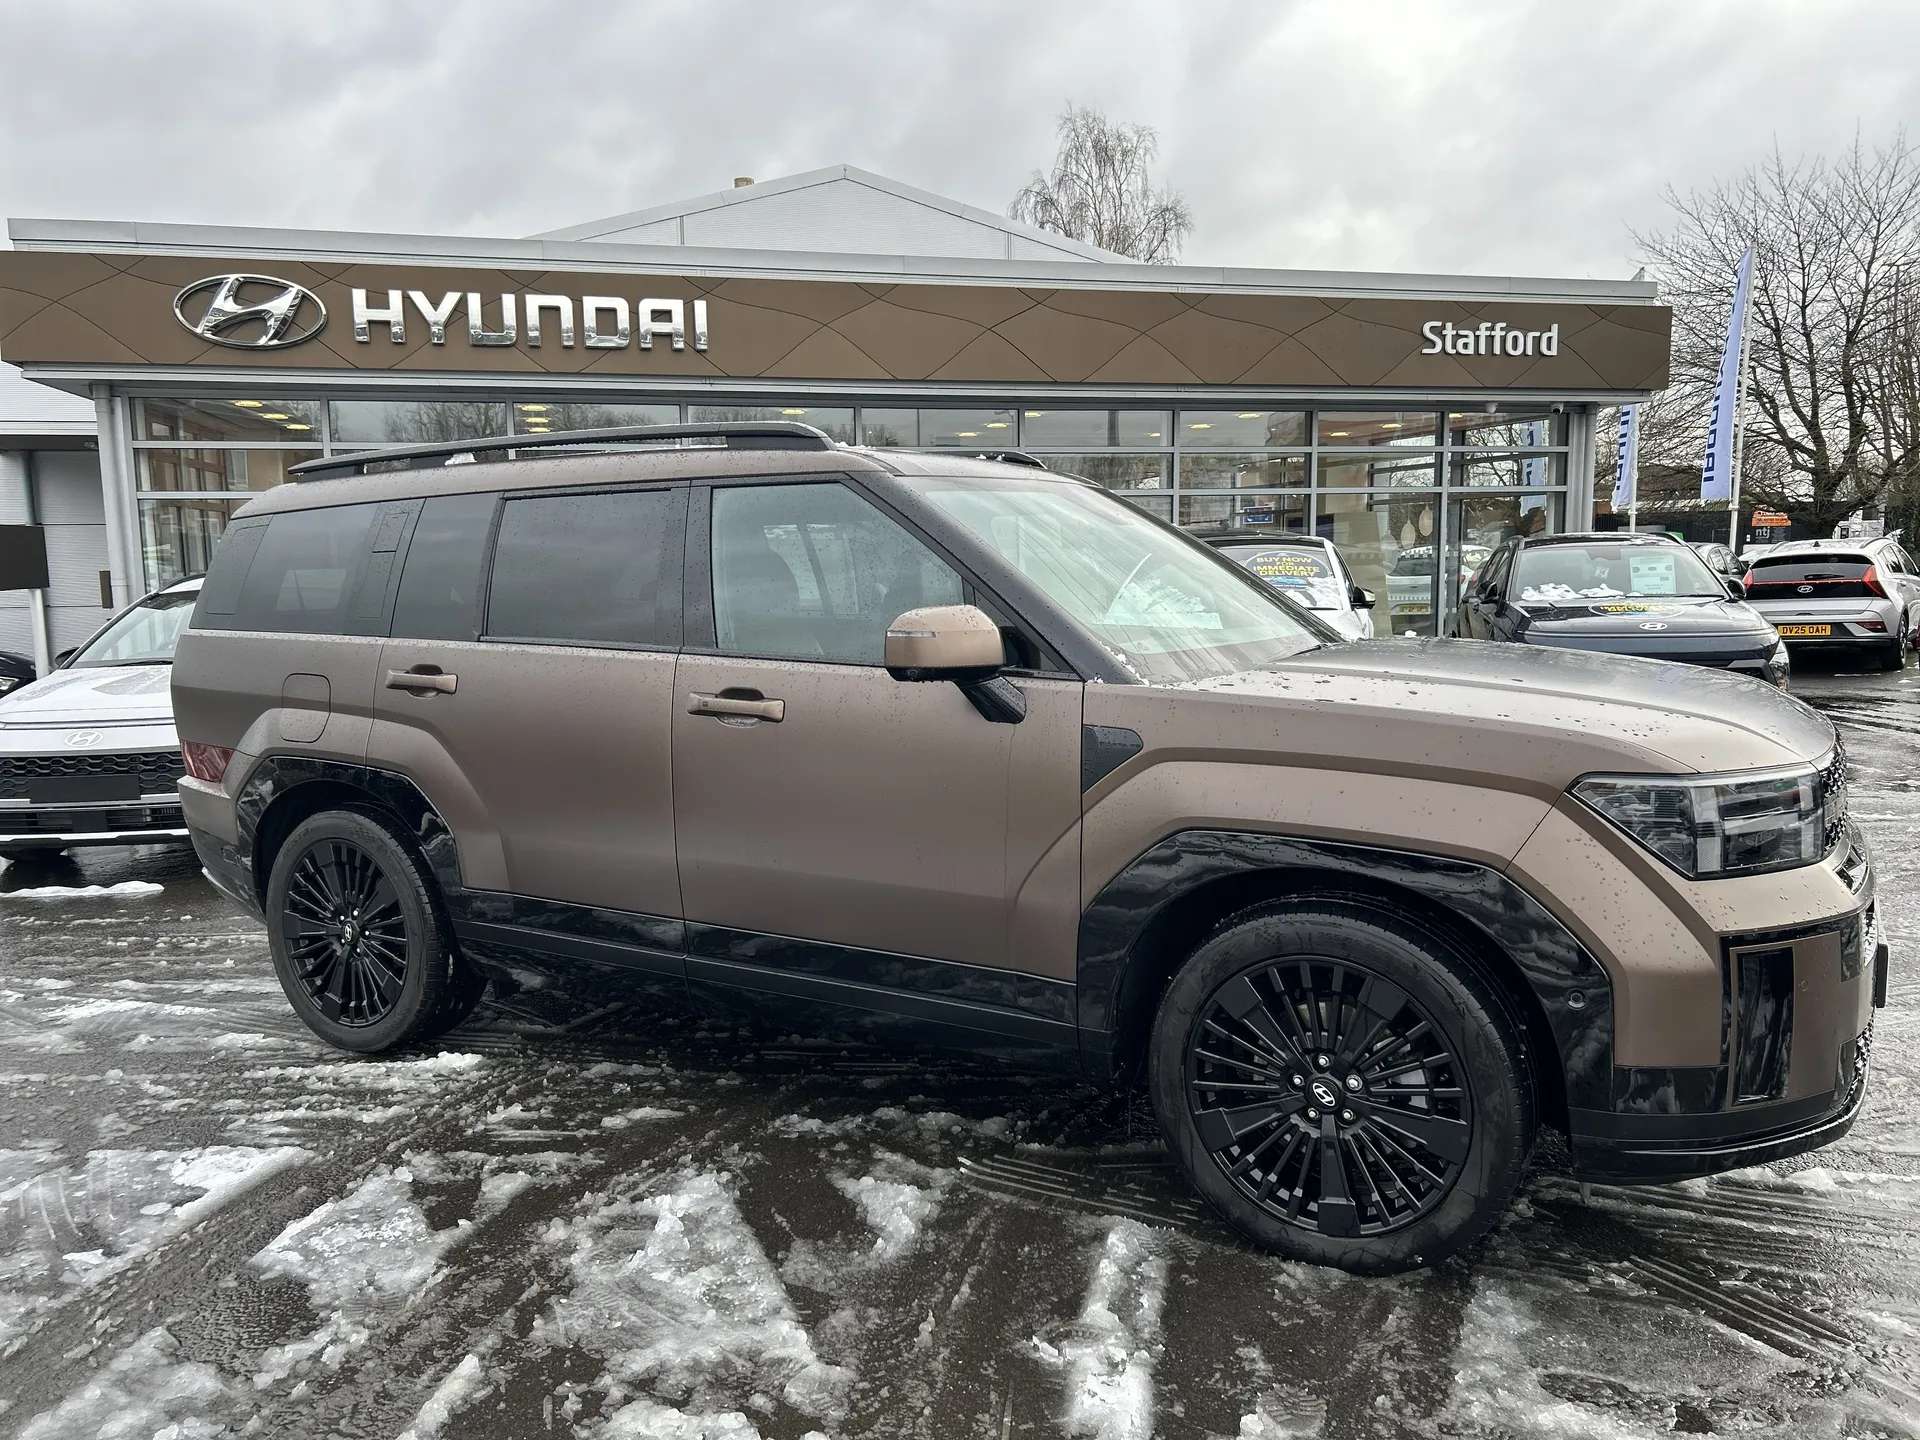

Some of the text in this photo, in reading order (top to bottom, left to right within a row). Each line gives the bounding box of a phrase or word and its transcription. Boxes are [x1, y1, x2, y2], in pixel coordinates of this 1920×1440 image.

[351, 287, 709, 352] HYUNDAI
[1421, 321, 1559, 356] Stafford
[1782, 626, 1807, 634] DV25
